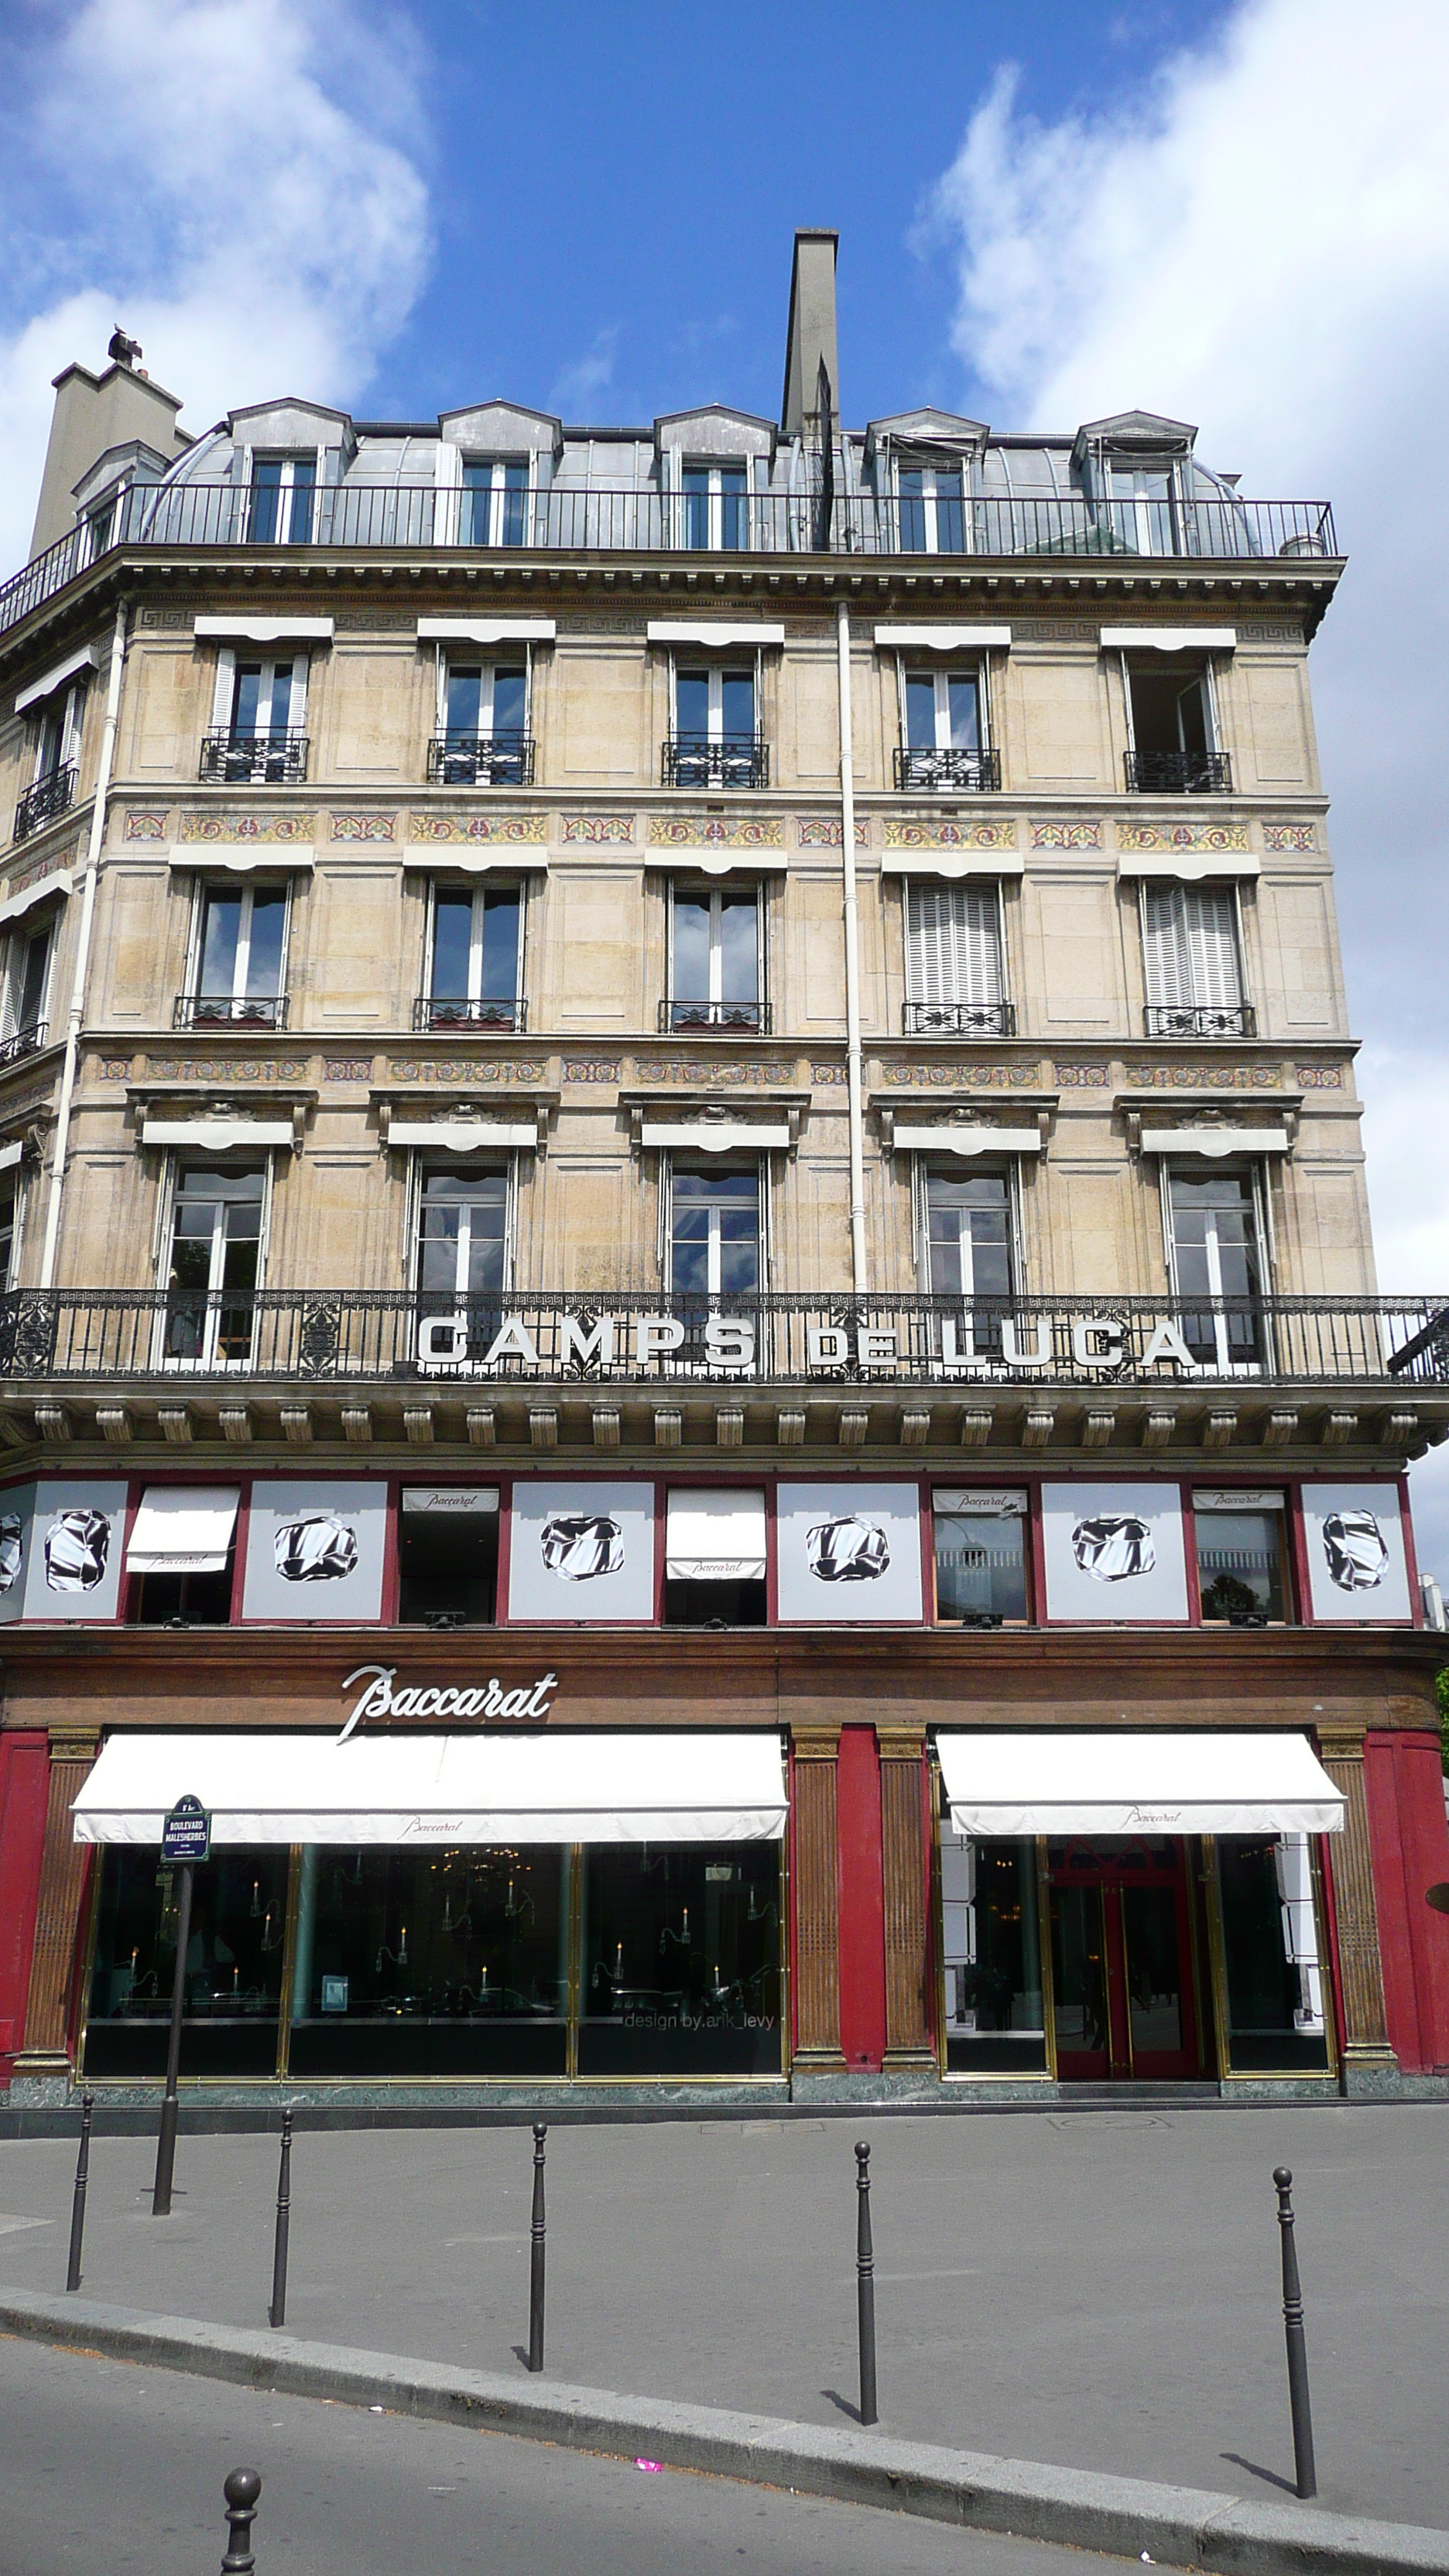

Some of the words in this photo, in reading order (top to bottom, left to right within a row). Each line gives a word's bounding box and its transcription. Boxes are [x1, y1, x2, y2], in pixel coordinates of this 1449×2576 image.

[419, 1316, 756, 1367] CAMPS
[809, 1327, 897, 1366] DE
[942, 1319, 1197, 1368] LUCA
[425, 1493, 478, 1509] Baccarat
[957, 1494, 1008, 1510] Baccarat
[1212, 1492, 1263, 1506] Baccarat
[146, 1551, 208, 1570] Baccarat
[692, 1560, 742, 1574] Baccarat
[336, 1665, 558, 1745] Baccarat
[170, 1821, 204, 1831] BOULEVARD
[1118, 1804, 1182, 1831] Baccarat
[396, 1814, 463, 1841] Baccarat
[625, 2012, 677, 2031] design
